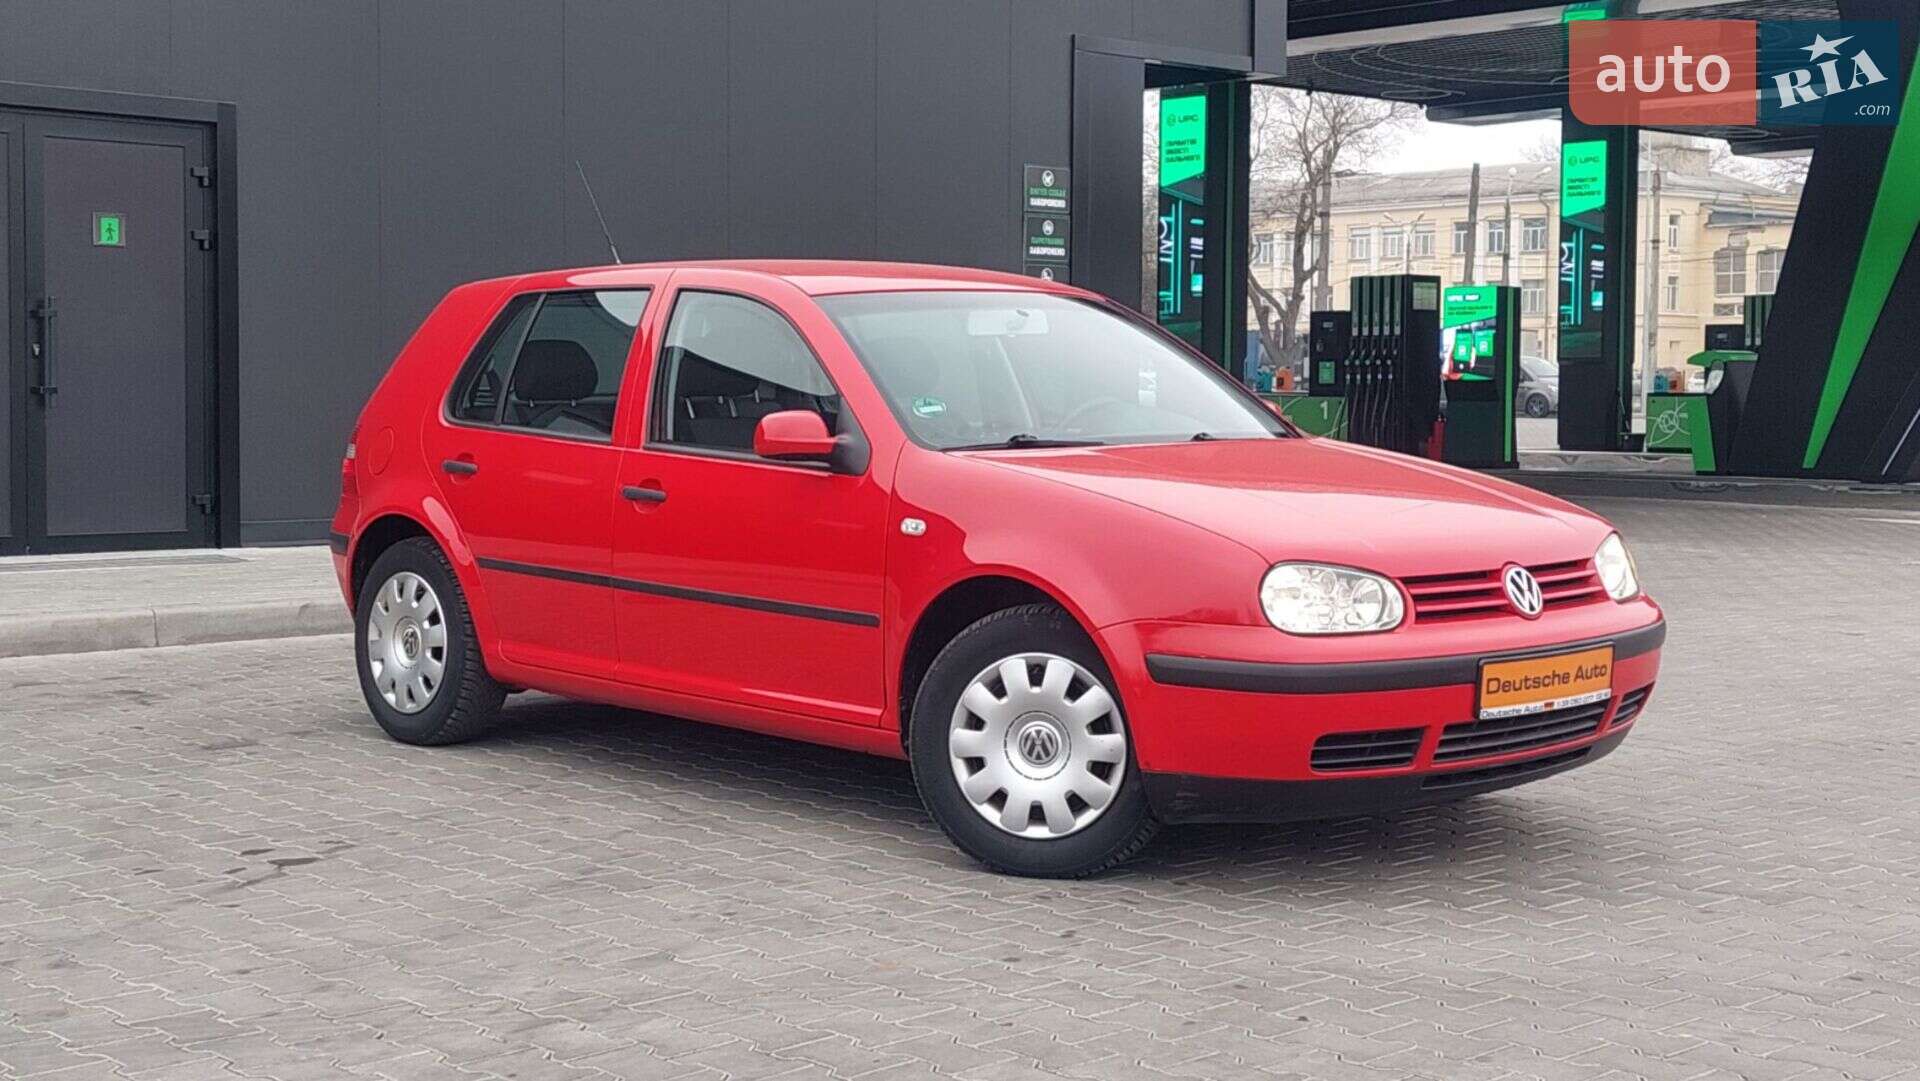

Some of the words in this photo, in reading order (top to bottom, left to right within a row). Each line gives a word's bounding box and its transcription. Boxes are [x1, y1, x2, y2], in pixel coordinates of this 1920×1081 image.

[1319, 400, 1328, 420] 1
[1486, 670, 1570, 695] Deutsche
[1573, 663, 1608, 682] Auto
[1481, 707, 1522, 719] Deutsche
